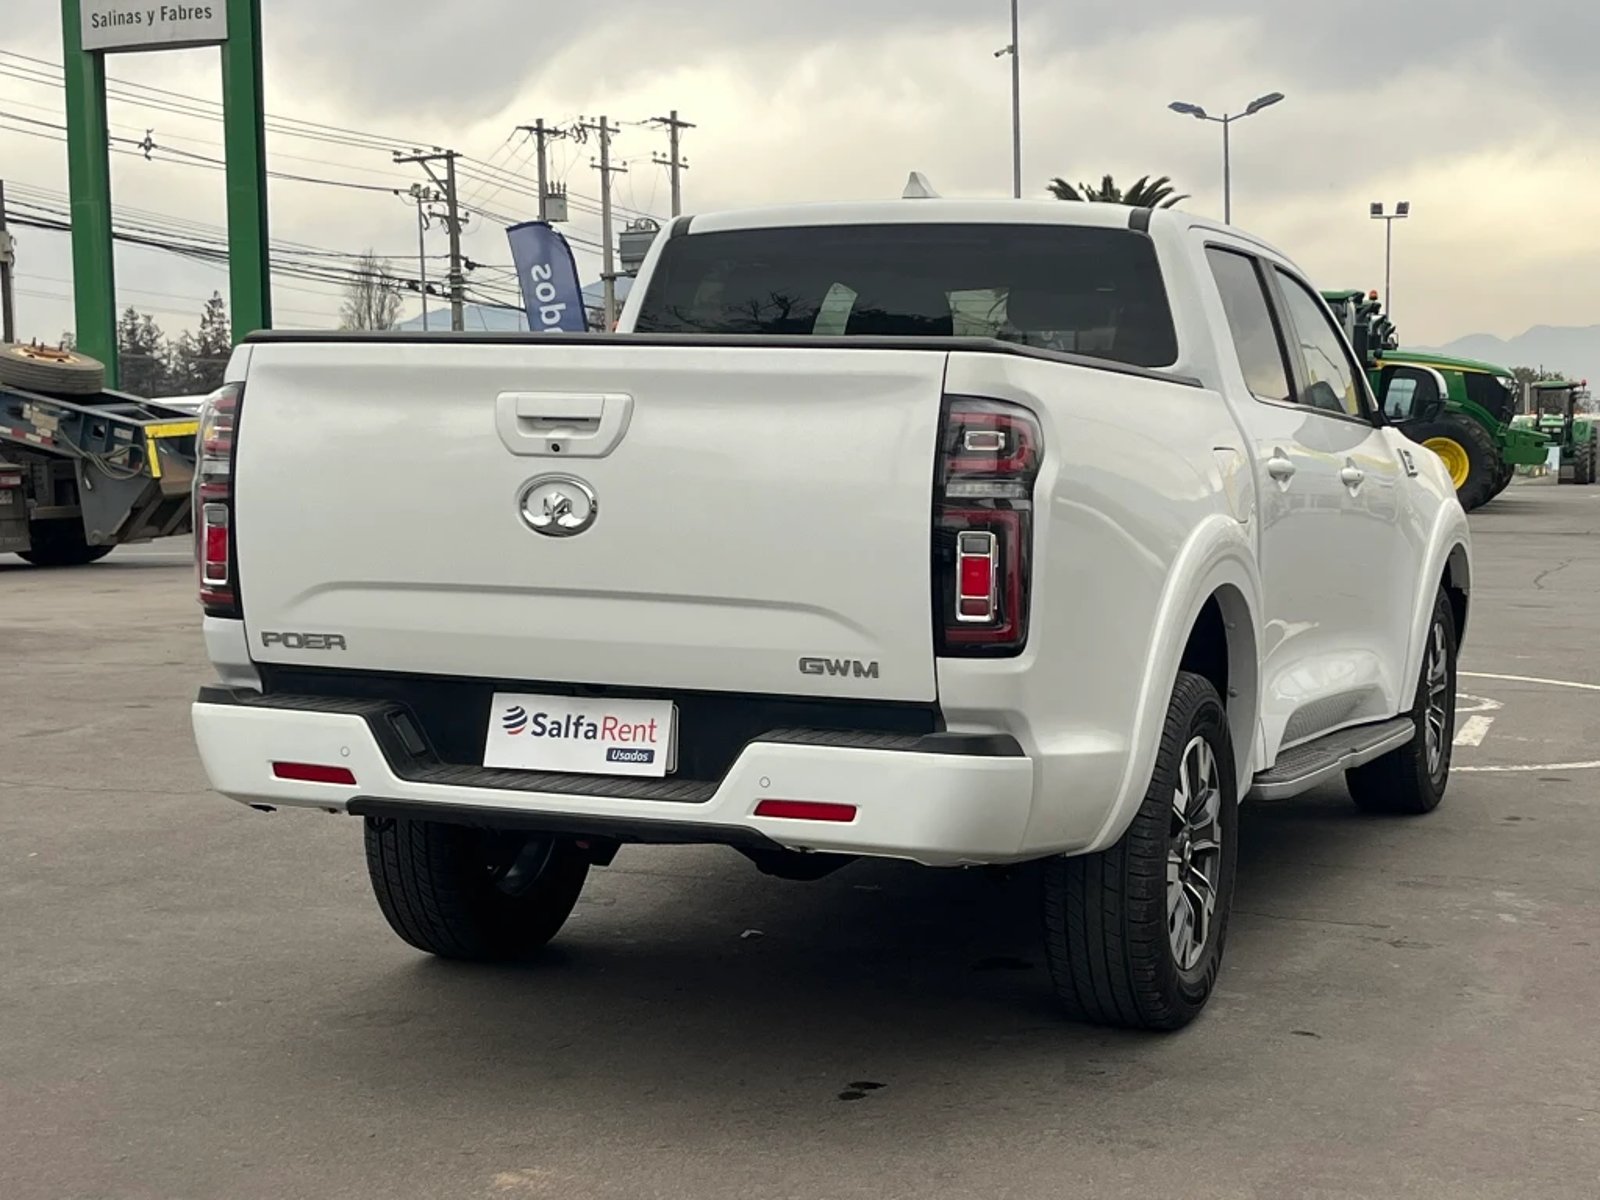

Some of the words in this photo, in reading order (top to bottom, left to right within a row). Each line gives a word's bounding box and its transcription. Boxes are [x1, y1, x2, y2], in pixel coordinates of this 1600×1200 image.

[91, 11, 142, 29] Salinas
[147, 10, 155, 26] y
[160, 5, 212, 22] Fabres
[261, 631, 347, 651] POER
[799, 657, 879, 679] GWM
[531, 712, 658, 743] SalfaRent
[611, 749, 649, 762] Usados
